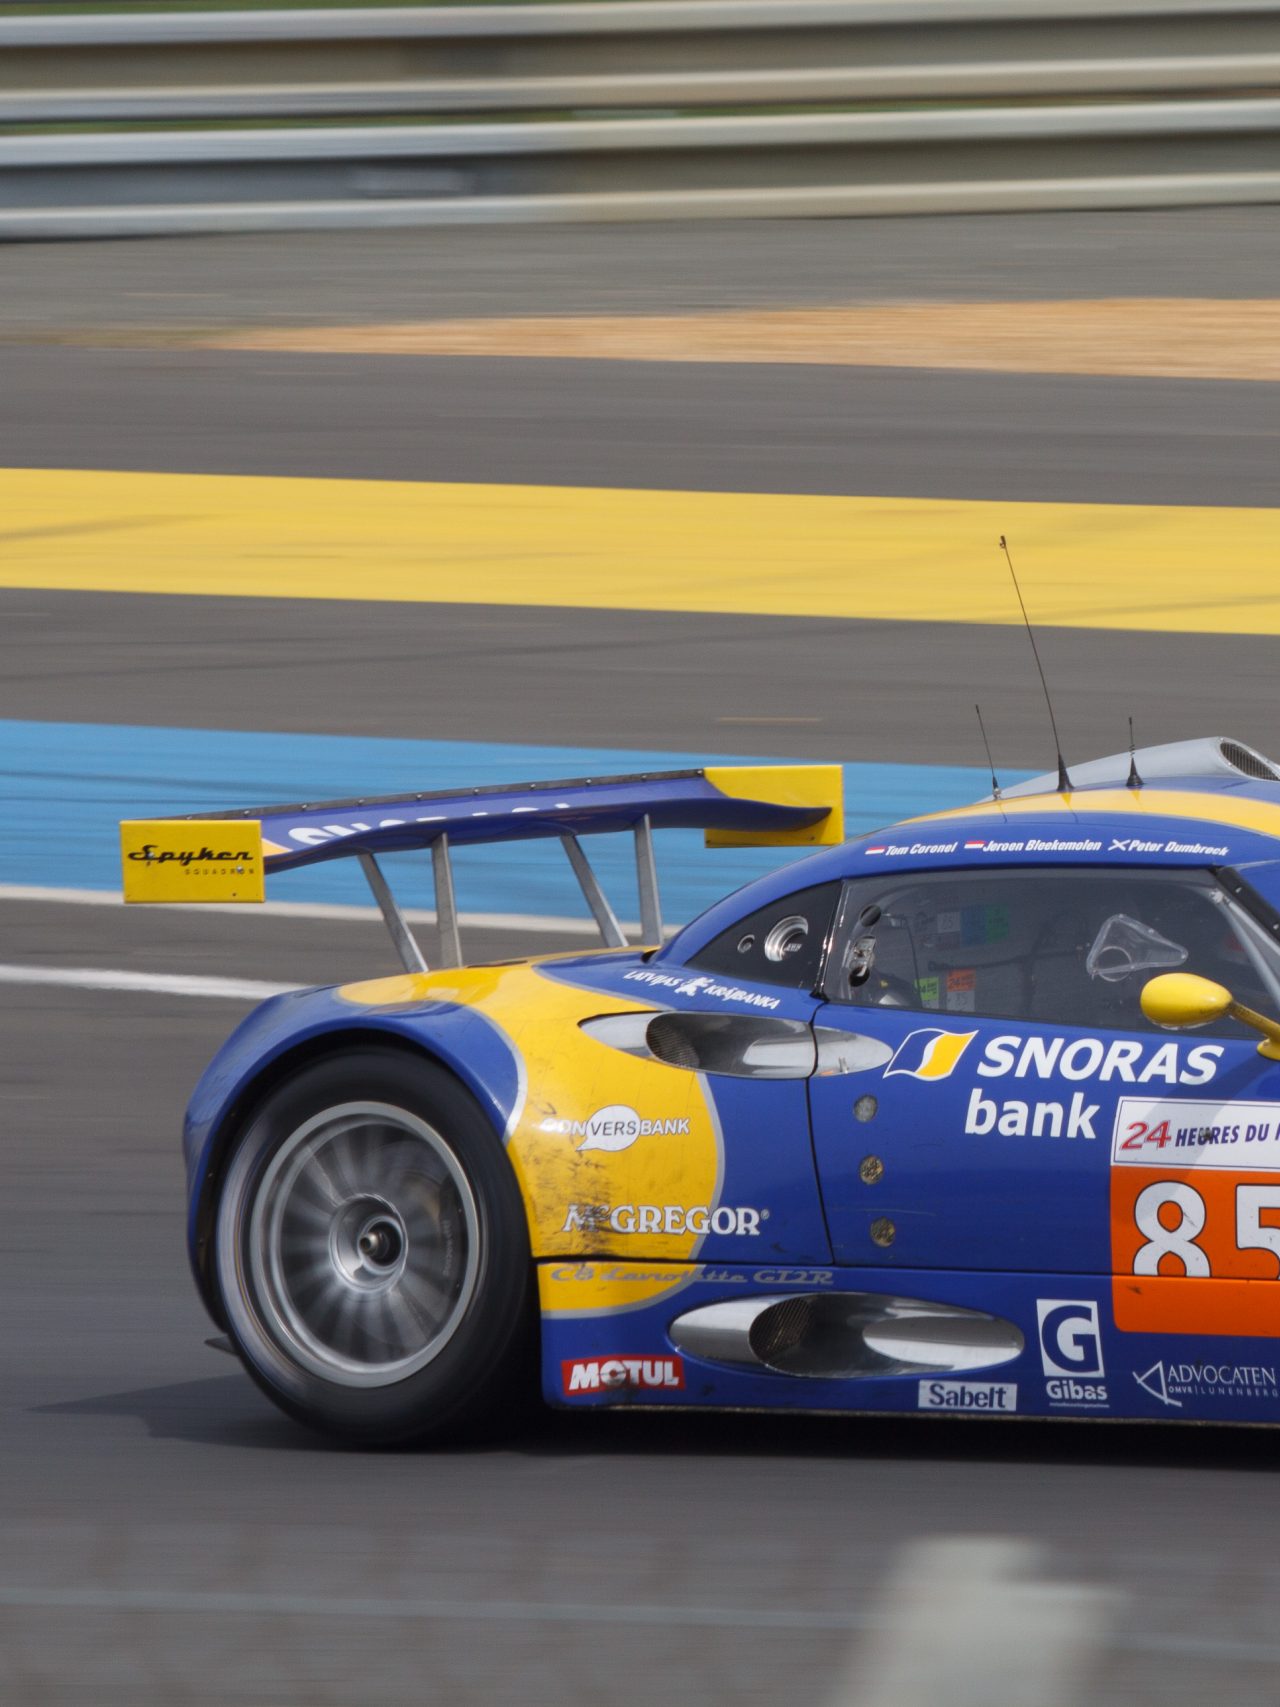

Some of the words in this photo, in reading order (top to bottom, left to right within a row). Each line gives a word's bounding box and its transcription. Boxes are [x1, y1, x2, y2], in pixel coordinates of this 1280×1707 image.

[128, 844, 254, 867] Spyker
[885, 845, 908, 857] Tom
[910, 841, 958, 855] Coronel
[983, 840, 1023, 852] Jeroen
[1025, 839, 1102, 852] Bleekemolen
[1128, 839, 1163, 852] Peter
[623, 970, 683, 987] LATVIJAS
[976, 1035, 1225, 1086] SNORAS
[964, 1088, 1101, 1140] bank
[538, 1117, 690, 1137] ONVERSBANK
[1119, 1120, 1172, 1151] 24
[1175, 1124, 1240, 1147] HEURES
[1245, 1123, 1270, 1142] DU
[752, 1269, 834, 1286] GT2R
[1041, 1303, 1099, 1374] G
[569, 1360, 680, 1391] MOTUL
[1167, 1364, 1277, 1386] ADVOCATEN
[927, 1383, 1008, 1409] Sabelt
[1046, 1379, 1108, 1401] Gibas
